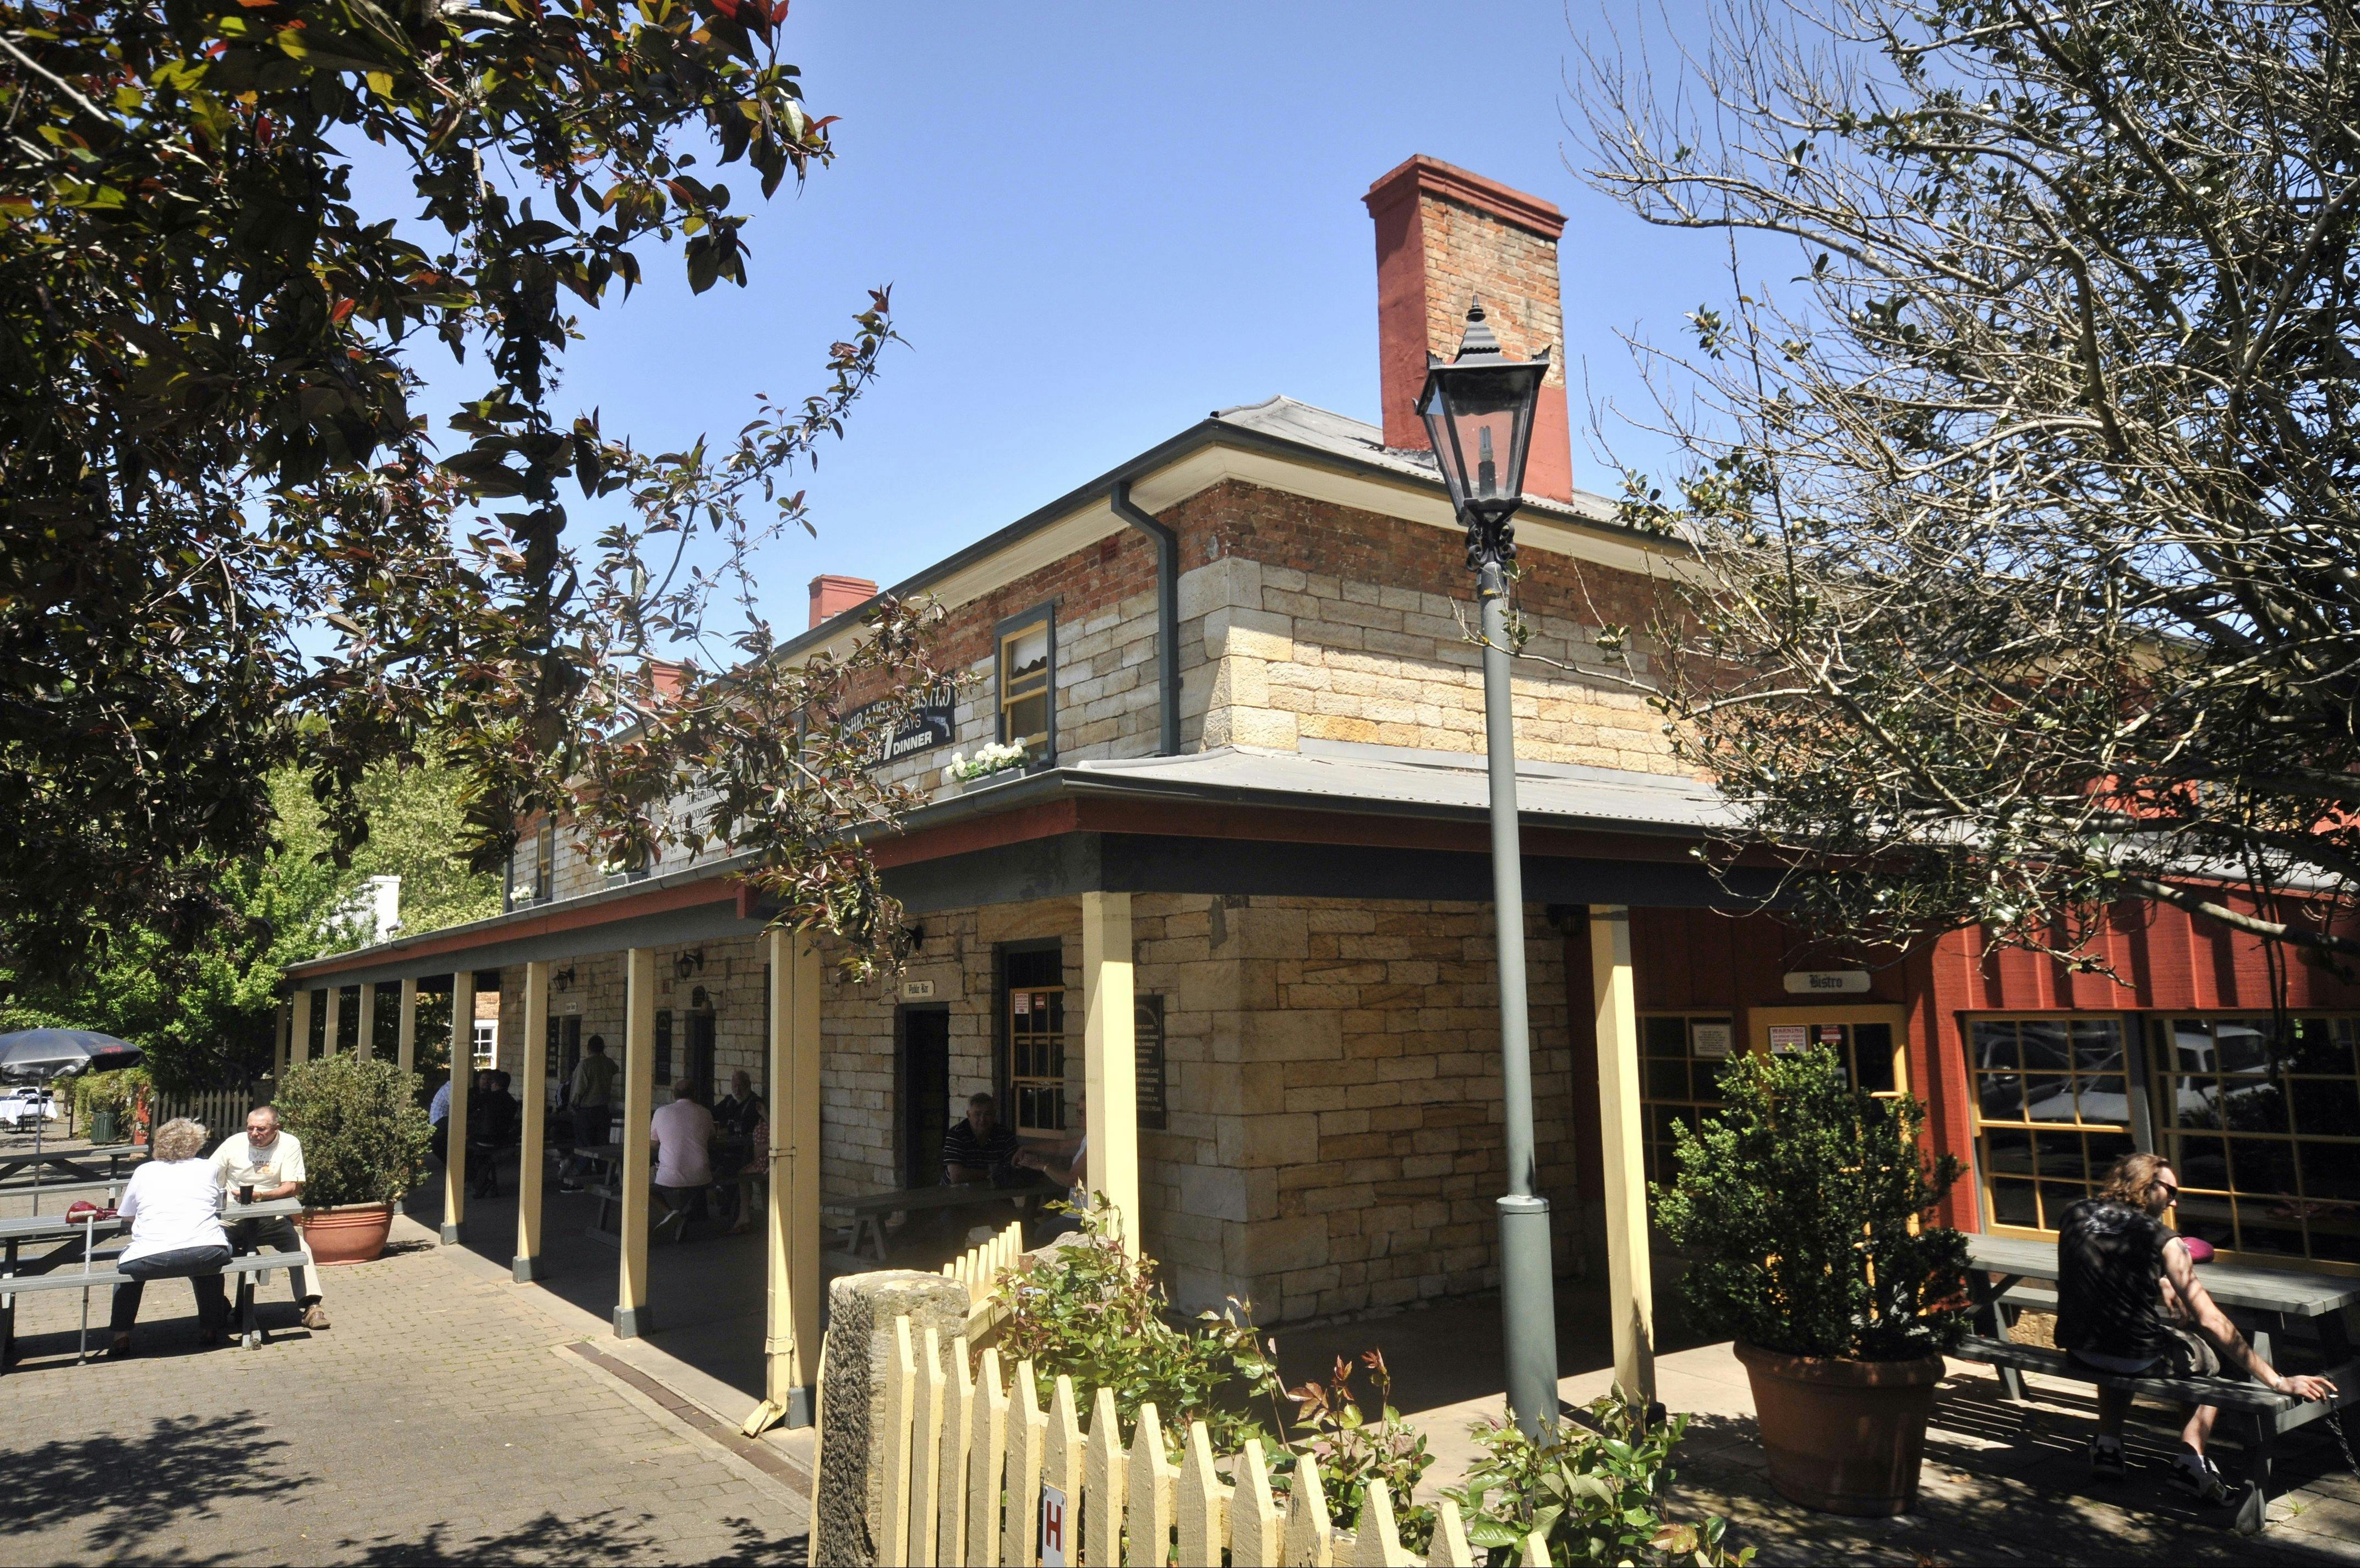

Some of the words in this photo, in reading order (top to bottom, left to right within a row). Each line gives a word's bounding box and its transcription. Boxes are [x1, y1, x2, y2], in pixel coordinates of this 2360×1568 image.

[838, 698, 906, 741] USHRANGR
[898, 713, 921, 734] DAYS
[893, 731, 932, 755] DINNER
[686, 788, 715, 806] Astralia
[1809, 974, 1843, 988] Bistro
[1046, 1500, 1062, 1553] H
